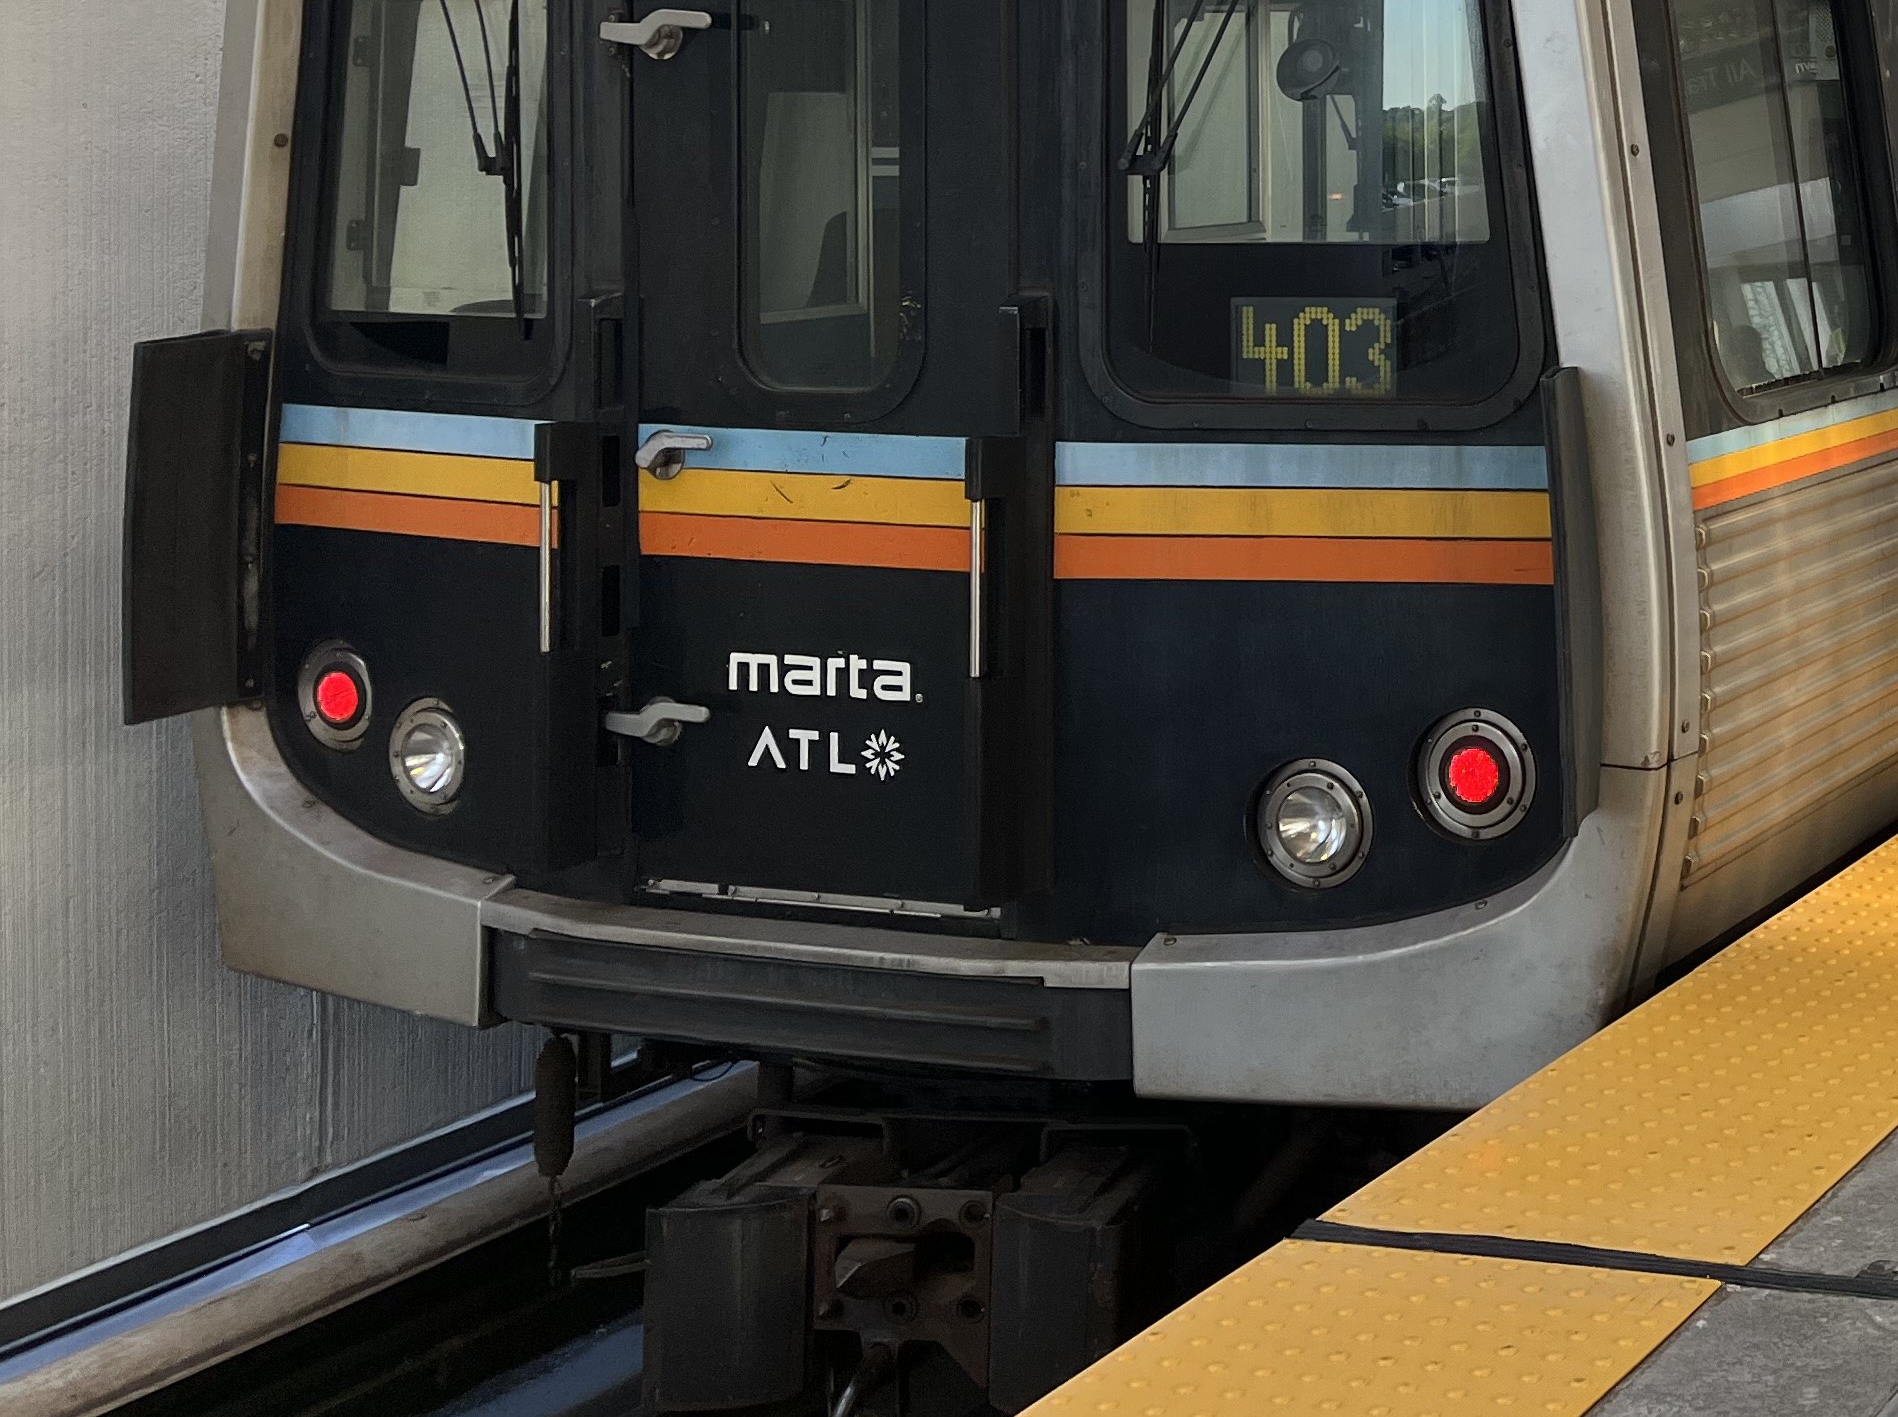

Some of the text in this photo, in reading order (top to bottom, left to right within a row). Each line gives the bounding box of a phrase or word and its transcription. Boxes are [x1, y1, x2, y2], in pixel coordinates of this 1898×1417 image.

[1241, 305, 1391, 396] 403
[728, 651, 911, 703] marta
[747, 725, 857, 775] ATL
